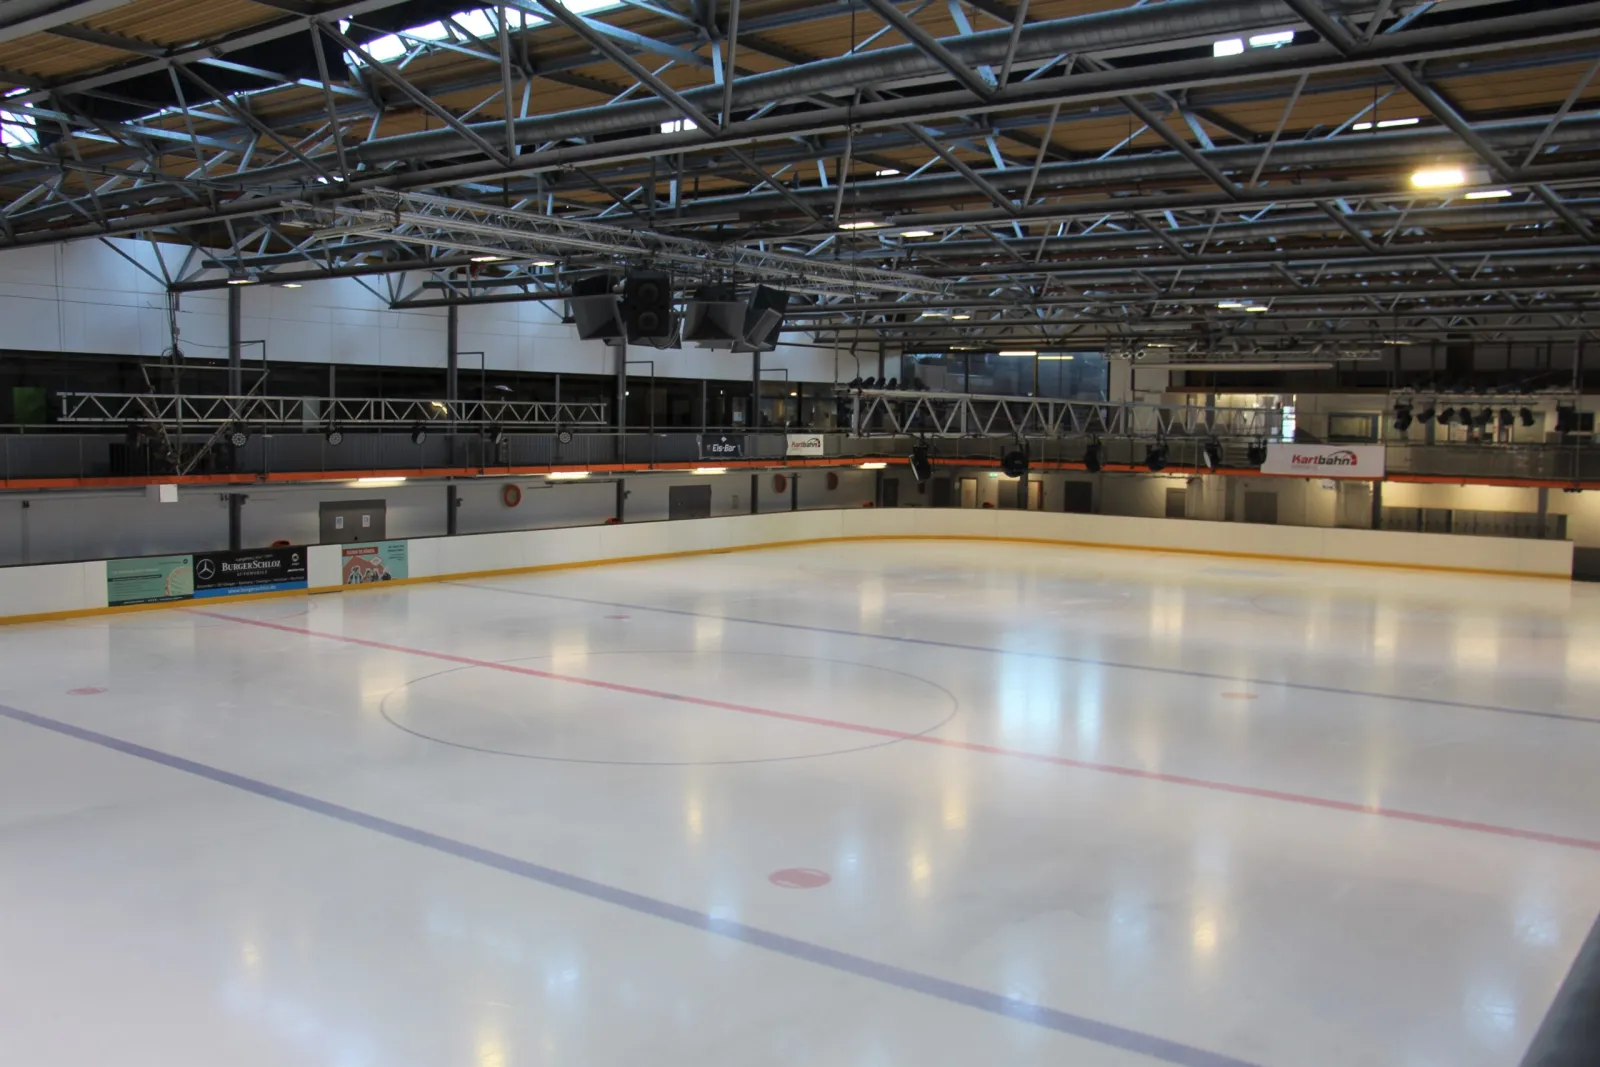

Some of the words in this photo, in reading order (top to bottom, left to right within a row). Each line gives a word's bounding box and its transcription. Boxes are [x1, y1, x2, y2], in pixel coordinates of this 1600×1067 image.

[712, 443, 736, 452] Eis-Bar
[792, 440, 818, 448] Kartbahn
[1292, 454, 1350, 465] Kartbahn
